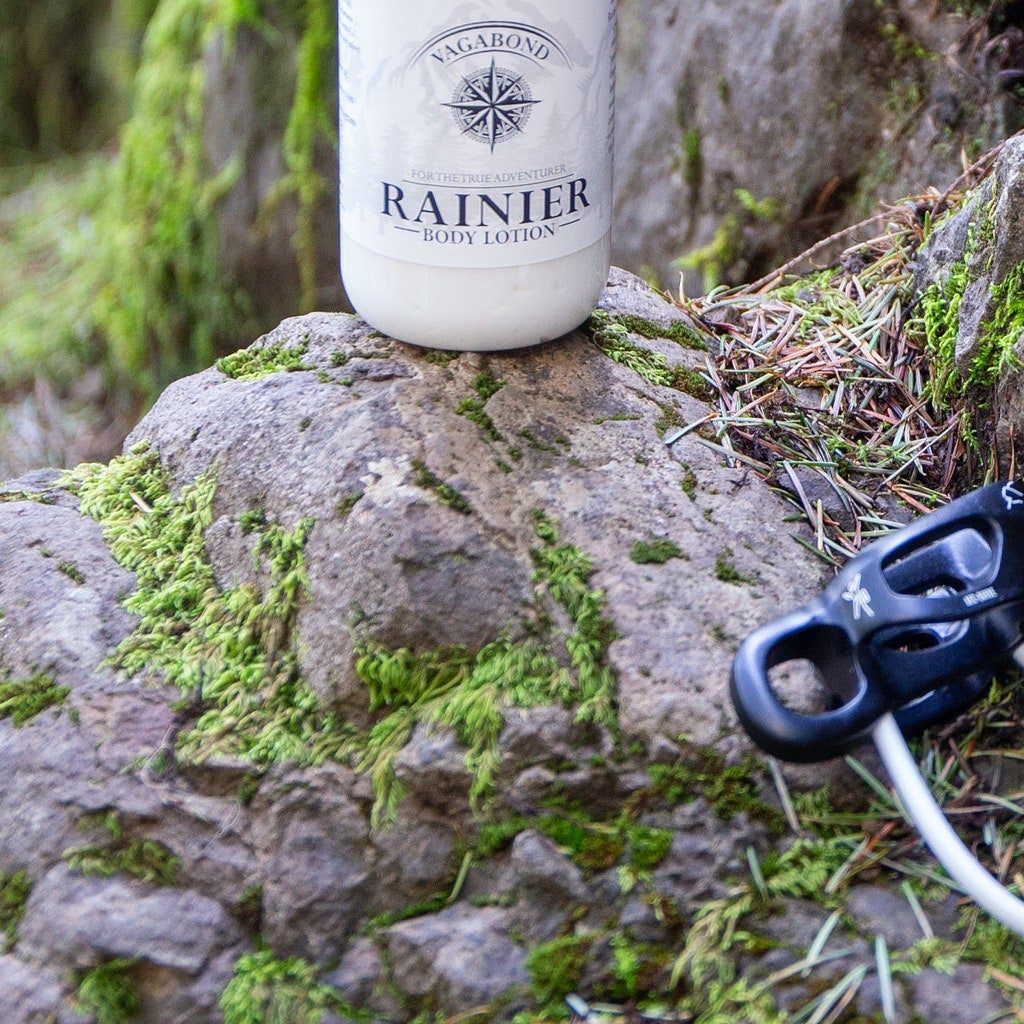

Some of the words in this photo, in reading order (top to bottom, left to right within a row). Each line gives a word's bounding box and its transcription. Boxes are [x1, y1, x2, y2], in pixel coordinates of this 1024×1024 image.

[431, 33, 549, 63] VAGABOND
[411, 169, 434, 181] FOR
[435, 171, 459, 182] THE
[460, 172, 491, 183] TRUE
[493, 164, 567, 183] ADVENTURER
[380, 178, 590, 226] RAINIER
[422, 228, 477, 244] BODY
[484, 223, 556, 244] LOTION
